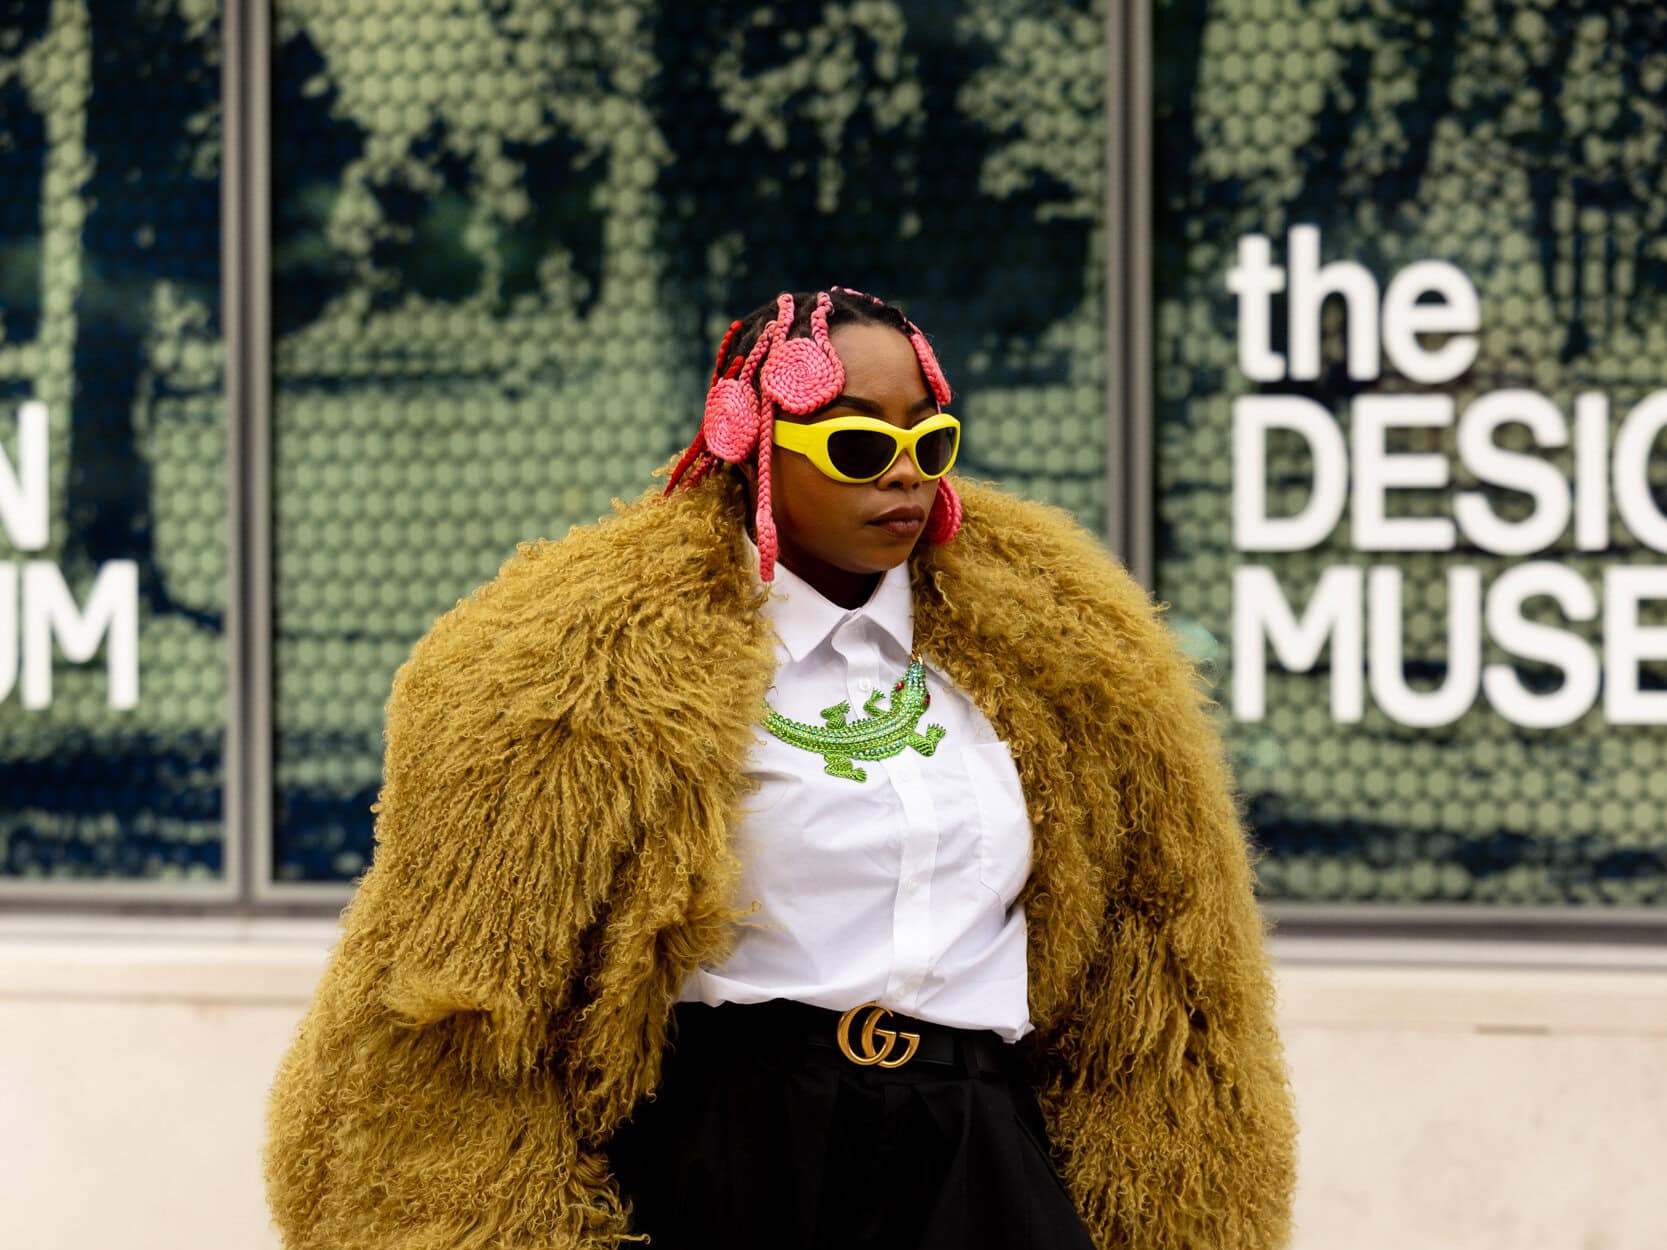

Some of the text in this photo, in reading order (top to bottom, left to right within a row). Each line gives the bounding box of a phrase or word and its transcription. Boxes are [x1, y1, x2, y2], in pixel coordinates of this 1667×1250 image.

[1226, 224, 1481, 383] the
[0, 559, 139, 711] M
[1232, 561, 1667, 727] MUSE
